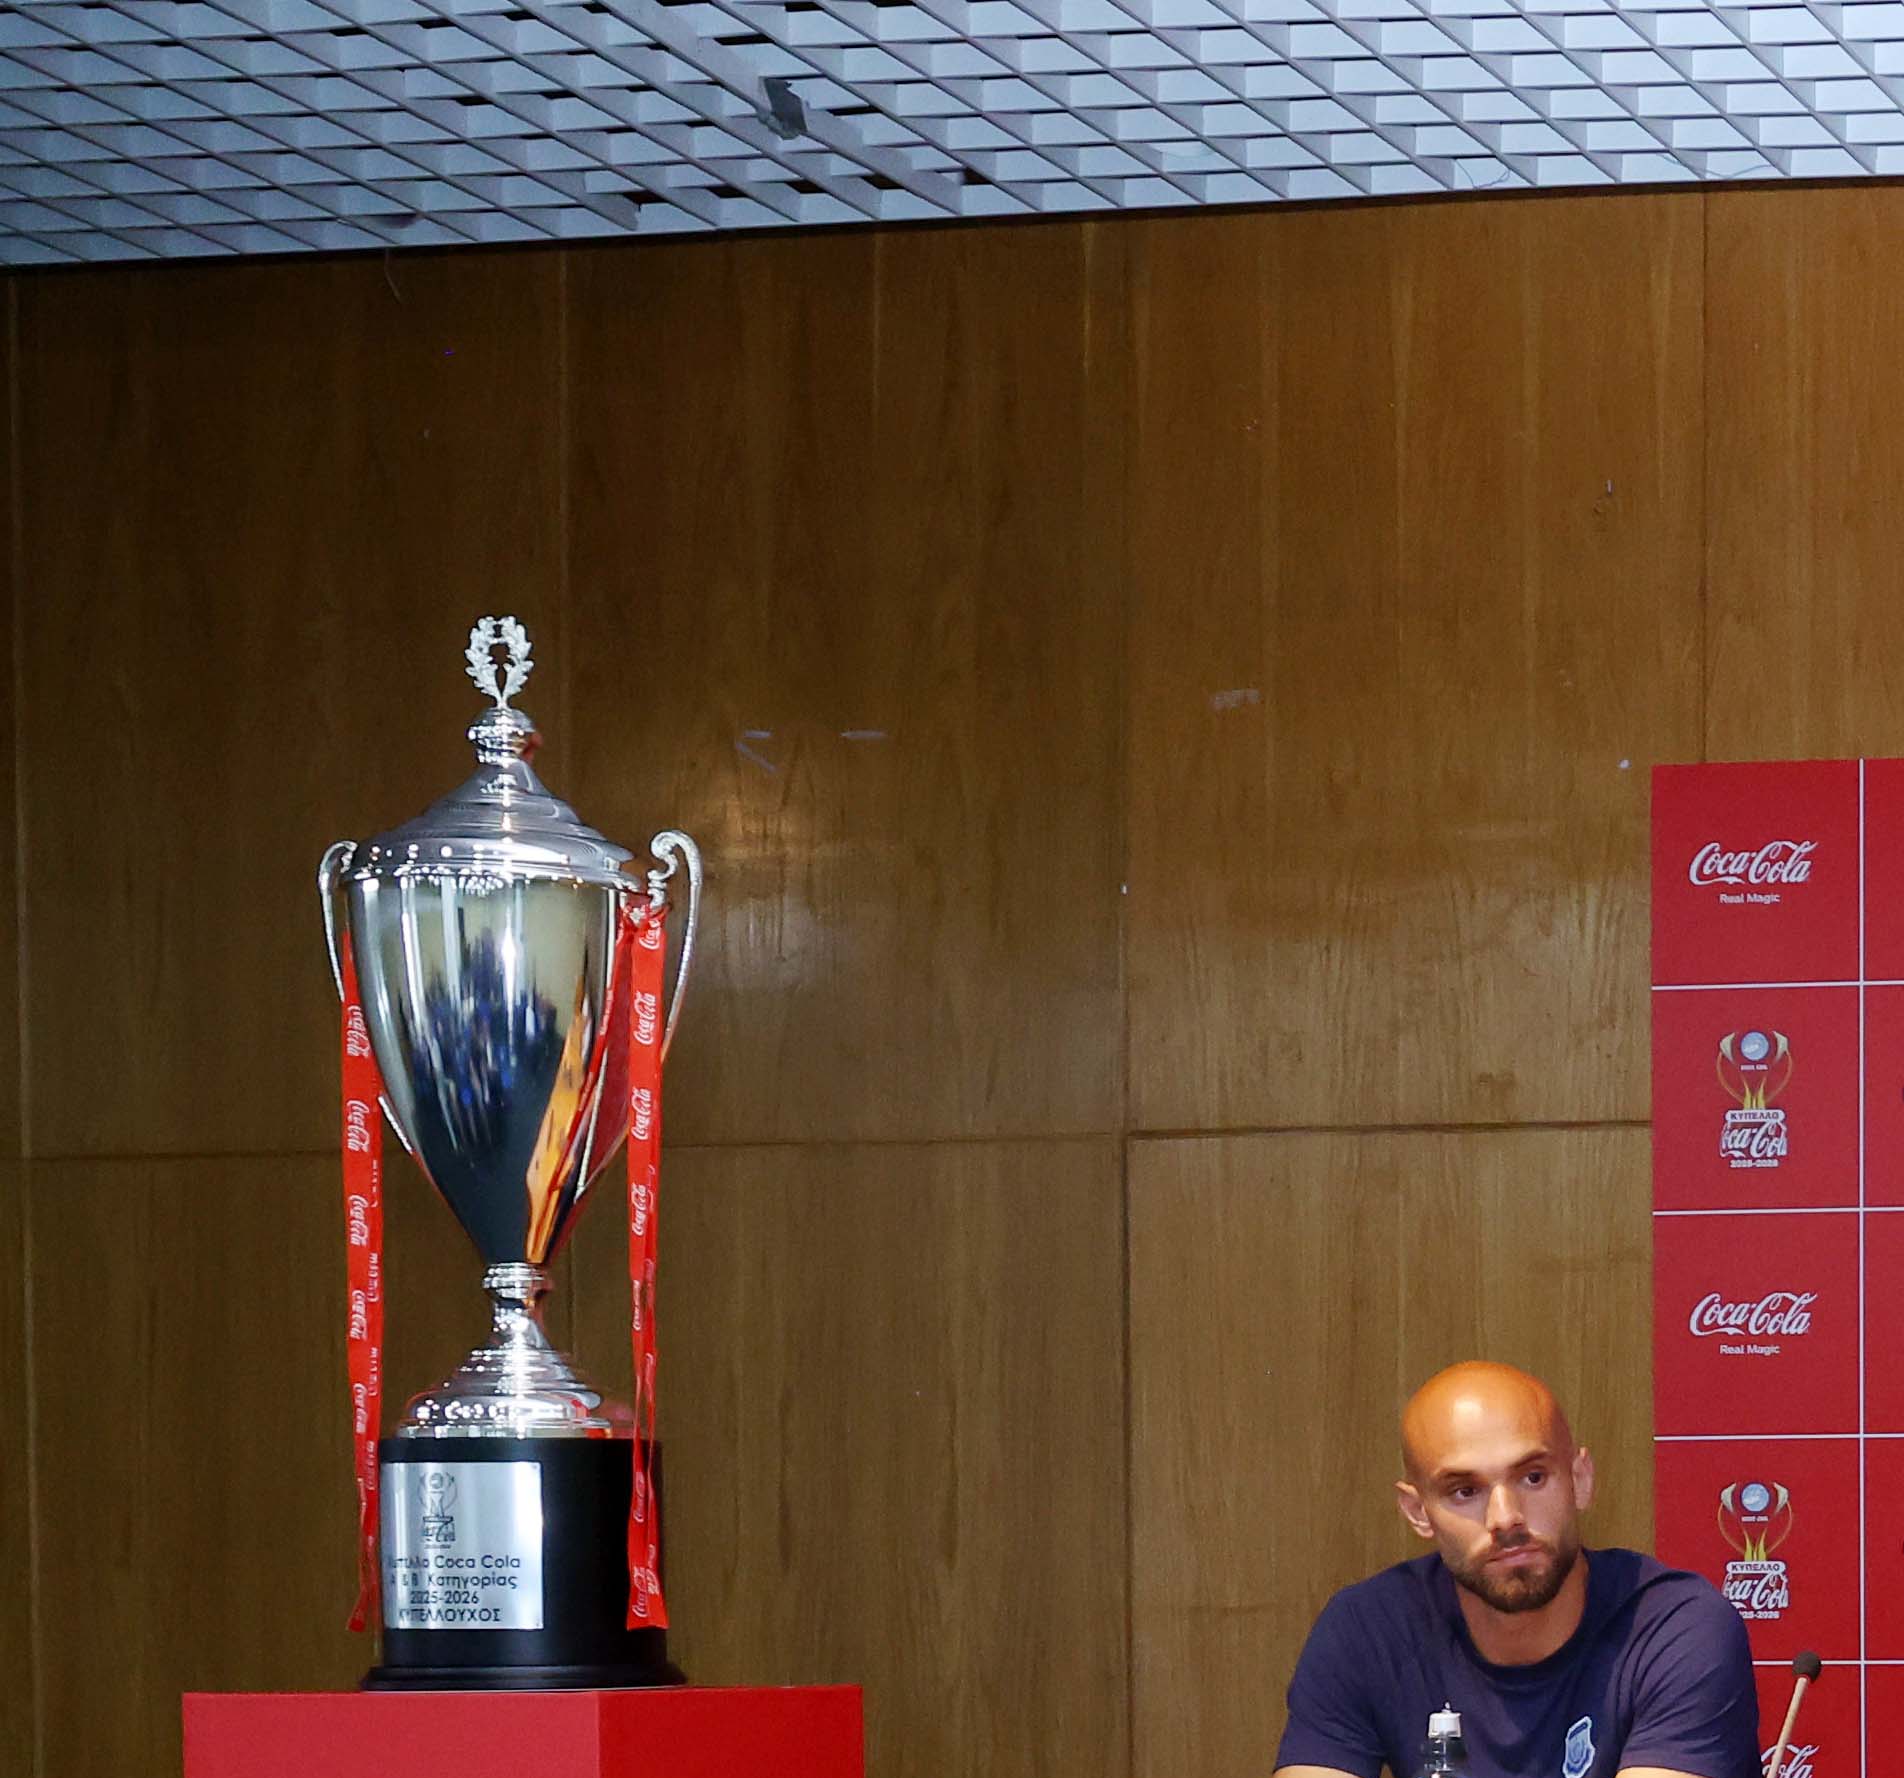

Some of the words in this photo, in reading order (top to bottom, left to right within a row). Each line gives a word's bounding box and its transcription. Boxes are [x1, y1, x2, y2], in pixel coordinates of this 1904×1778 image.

[1689, 841, 1818, 885] Coca-Cola
[1690, 1293, 1818, 1336] Coca-Cola
[434, 1555, 475, 1569] Coca
[481, 1555, 521, 1569] Cola
[428, 1571, 518, 1589] Κατηγορίας
